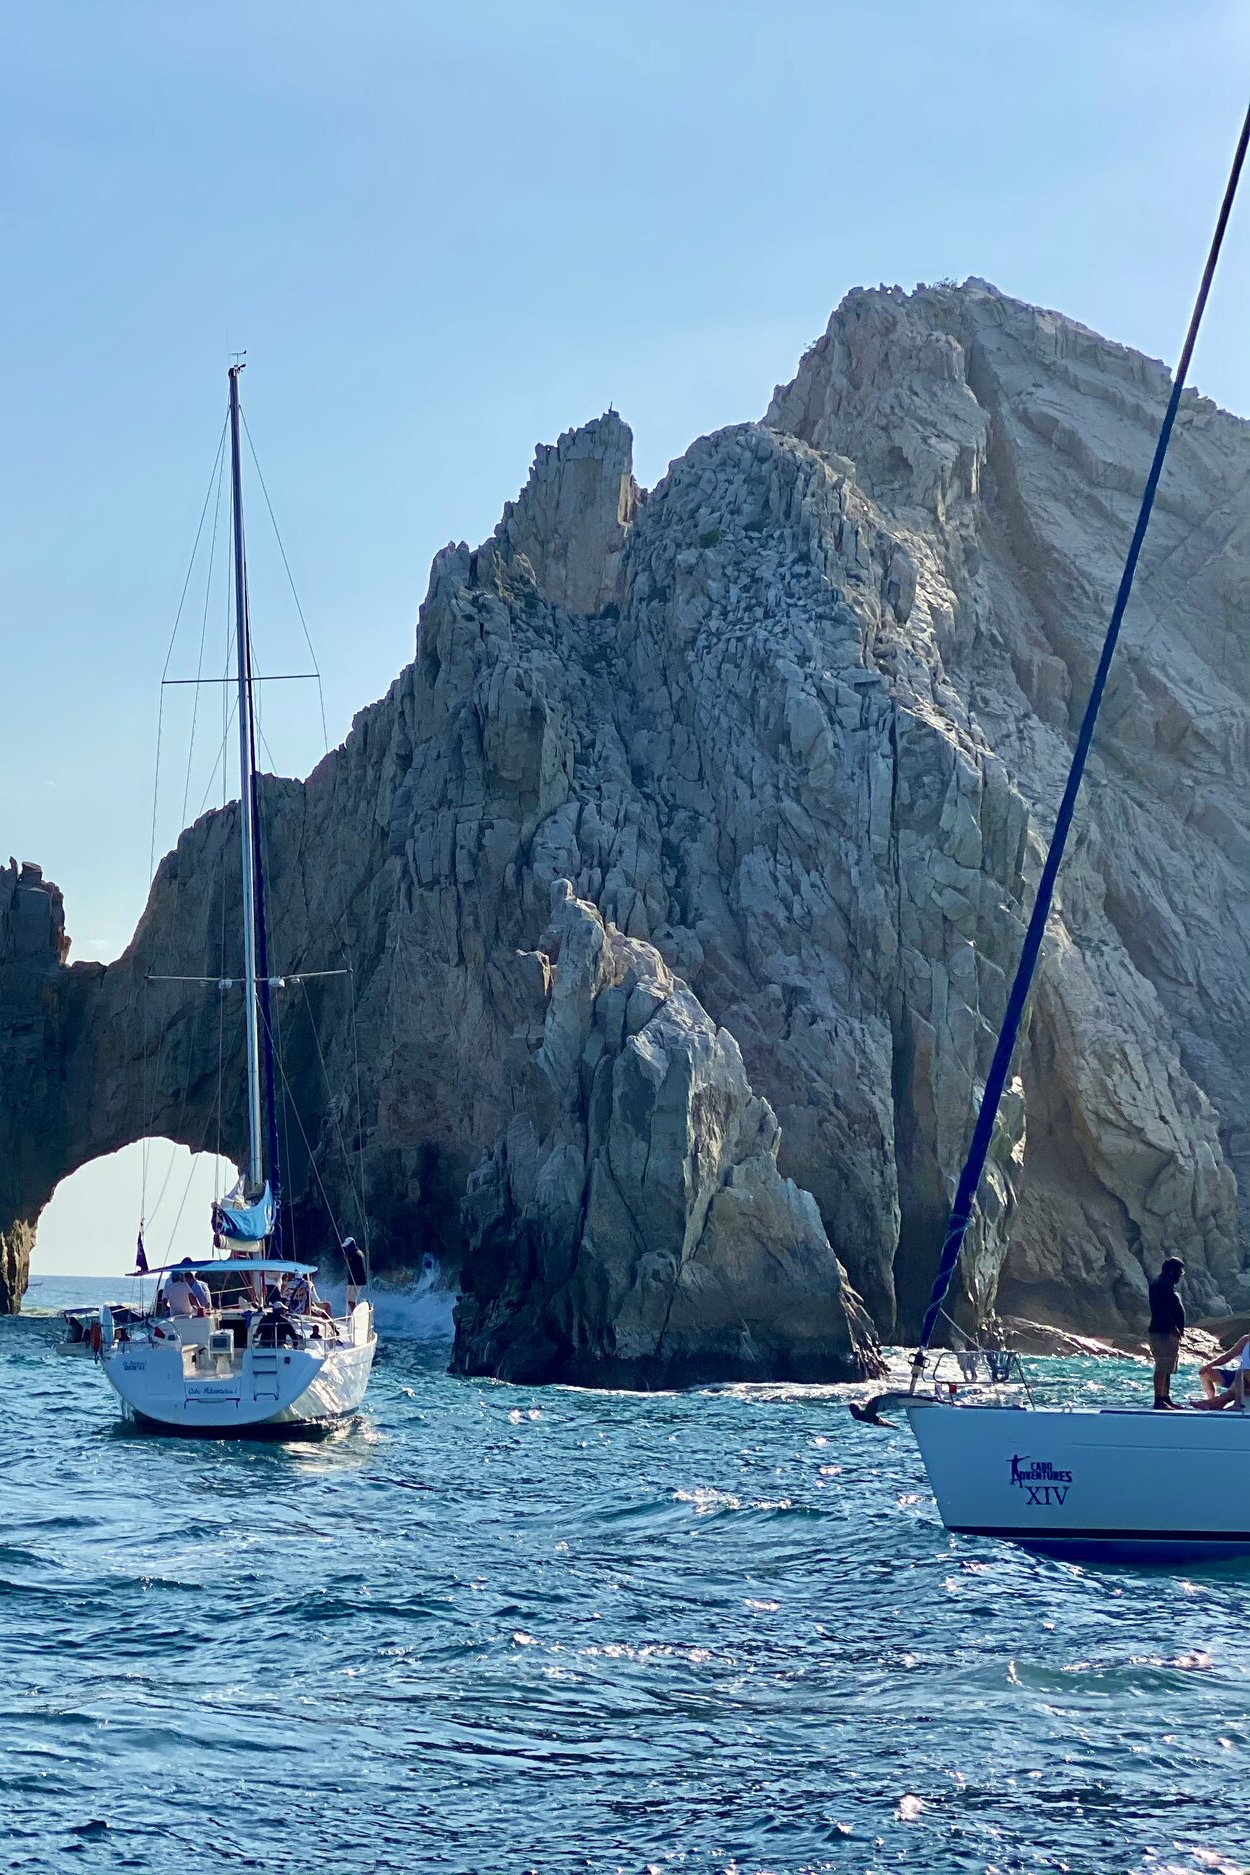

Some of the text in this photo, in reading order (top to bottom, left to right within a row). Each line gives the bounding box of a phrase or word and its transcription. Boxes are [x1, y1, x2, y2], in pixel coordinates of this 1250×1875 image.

[1031, 1462, 1052, 1471] CABO
[1011, 1470, 1072, 1484] ADVENTURES
[1025, 1486, 1070, 1505] XIV
